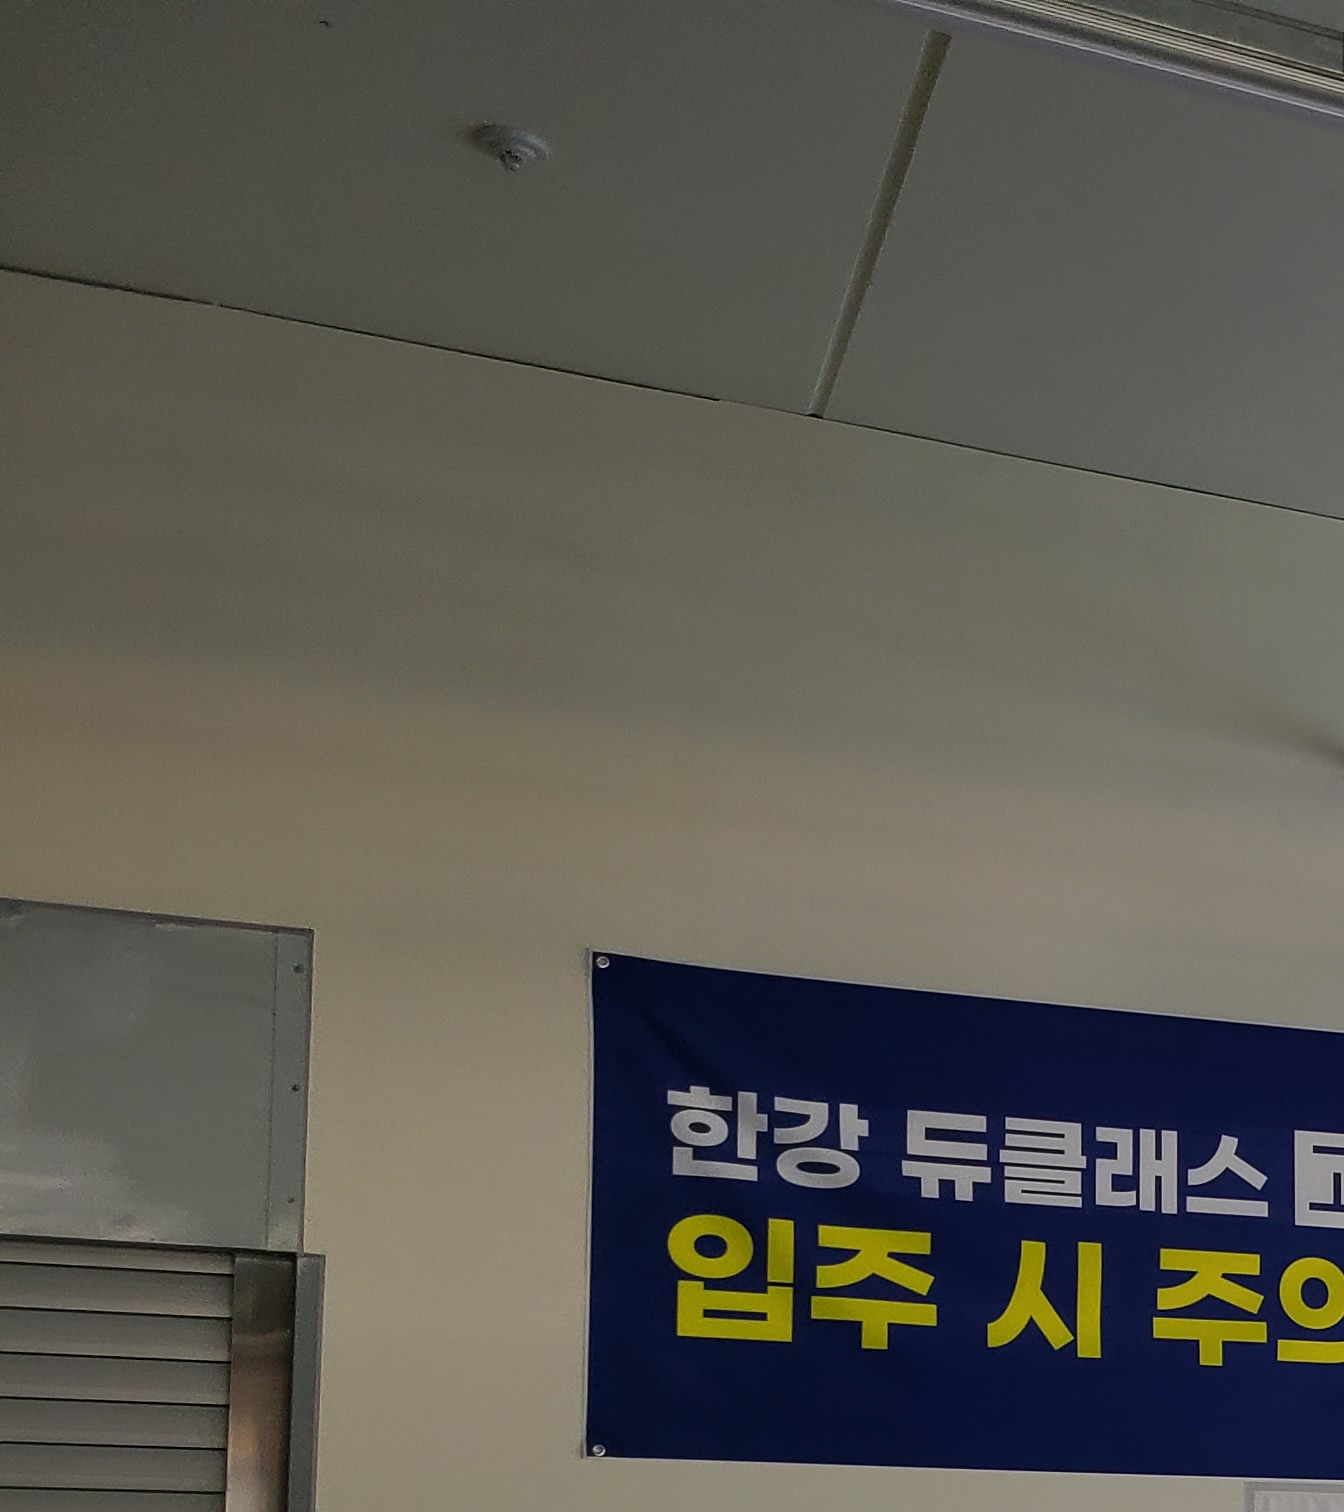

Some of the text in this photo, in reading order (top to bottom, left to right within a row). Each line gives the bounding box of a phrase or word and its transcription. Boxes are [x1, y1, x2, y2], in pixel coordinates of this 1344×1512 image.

[666, 1085, 869, 1189] 한강
[901, 1108, 1269, 1217] 듀클래스
[666, 1213, 938, 1349] 입주
[987, 1239, 1101, 1358] 시
